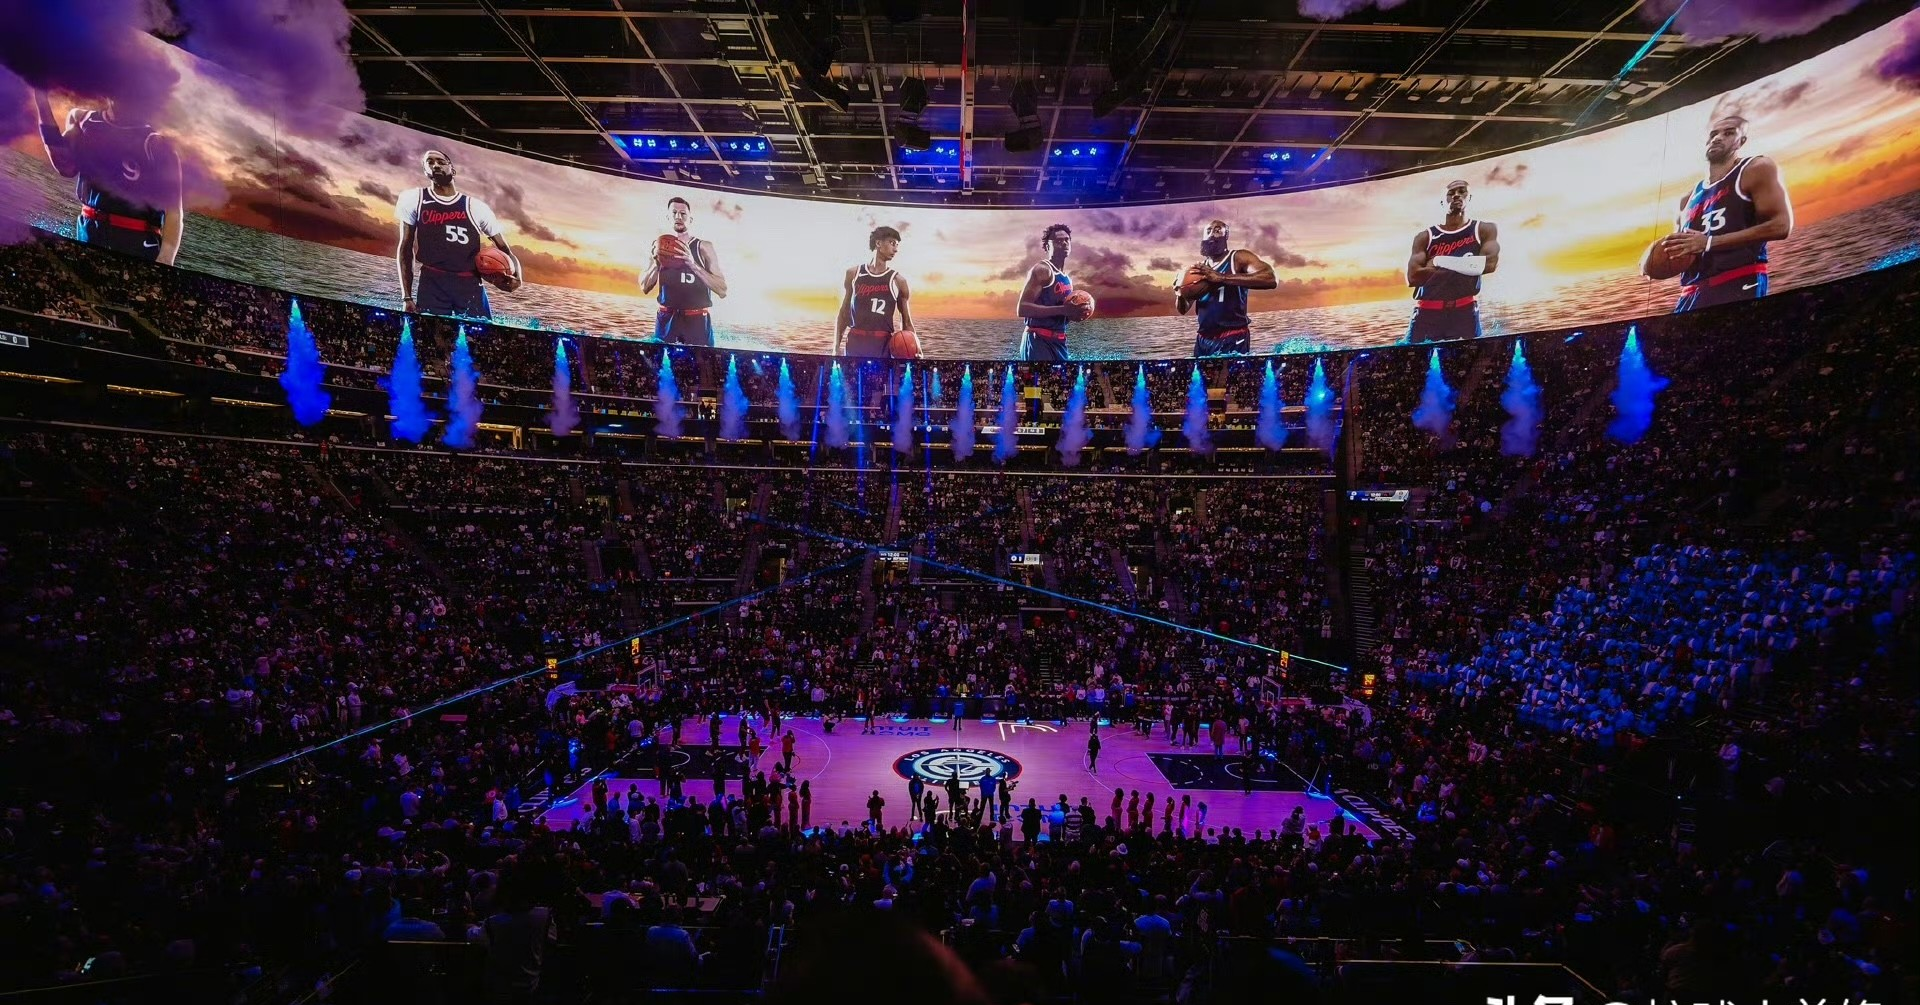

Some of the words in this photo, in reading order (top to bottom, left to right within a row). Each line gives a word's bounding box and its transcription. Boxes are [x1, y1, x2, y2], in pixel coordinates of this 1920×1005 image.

[421, 210, 467, 225] Clippers
[1700, 207, 1727, 235] 33
[445, 225, 470, 245] 55
[1427, 234, 1477, 256] Clippers
[857, 283, 889, 296] lippers
[1216, 286, 1226, 303] 1
[870, 298, 886, 315] 12
[904, 750, 930, 762] LOS
[940, 747, 1010, 764] ANGELES
